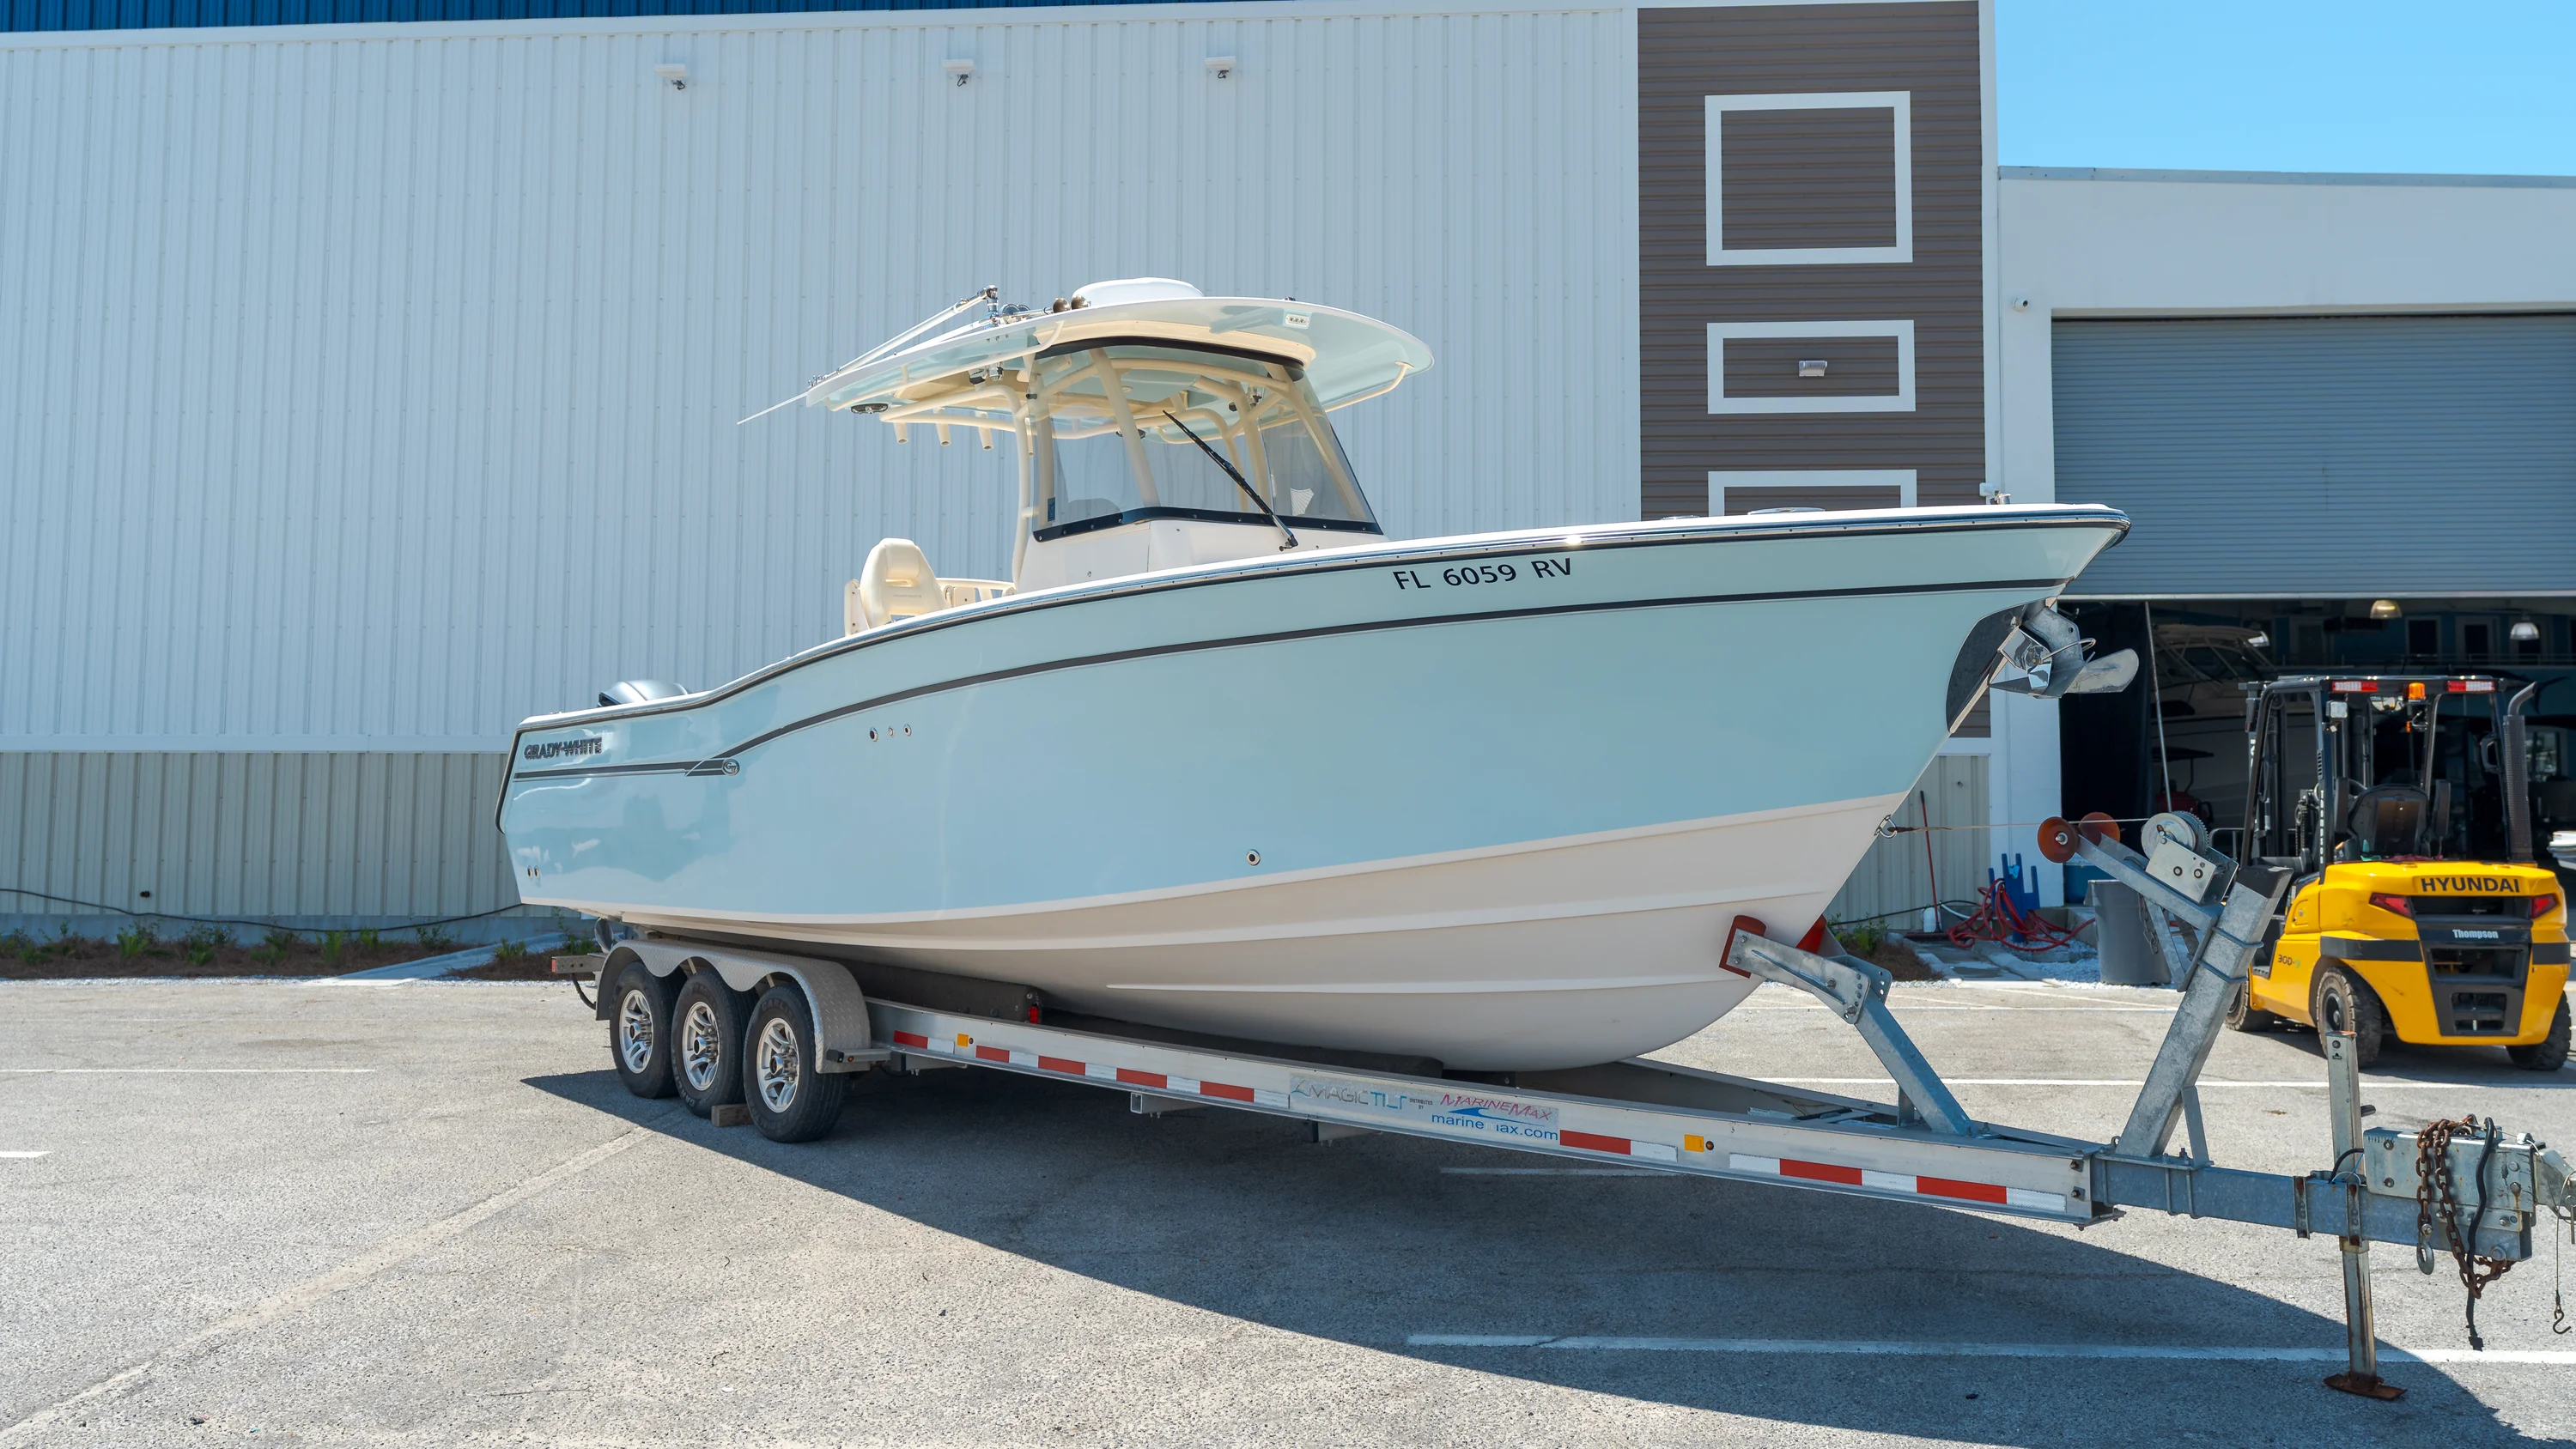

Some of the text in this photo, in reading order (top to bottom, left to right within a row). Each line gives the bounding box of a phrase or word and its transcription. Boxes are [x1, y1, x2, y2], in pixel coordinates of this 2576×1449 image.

[1392, 558, 1571, 590] FL 6059 RV
[524, 737, 602, 760] GRADY-WHITE
[2421, 877, 2520, 893] HYUNDAI
[2452, 929, 2499, 939] Thompson
[1409, 1097, 1433, 1106] DISTRIBUTED
